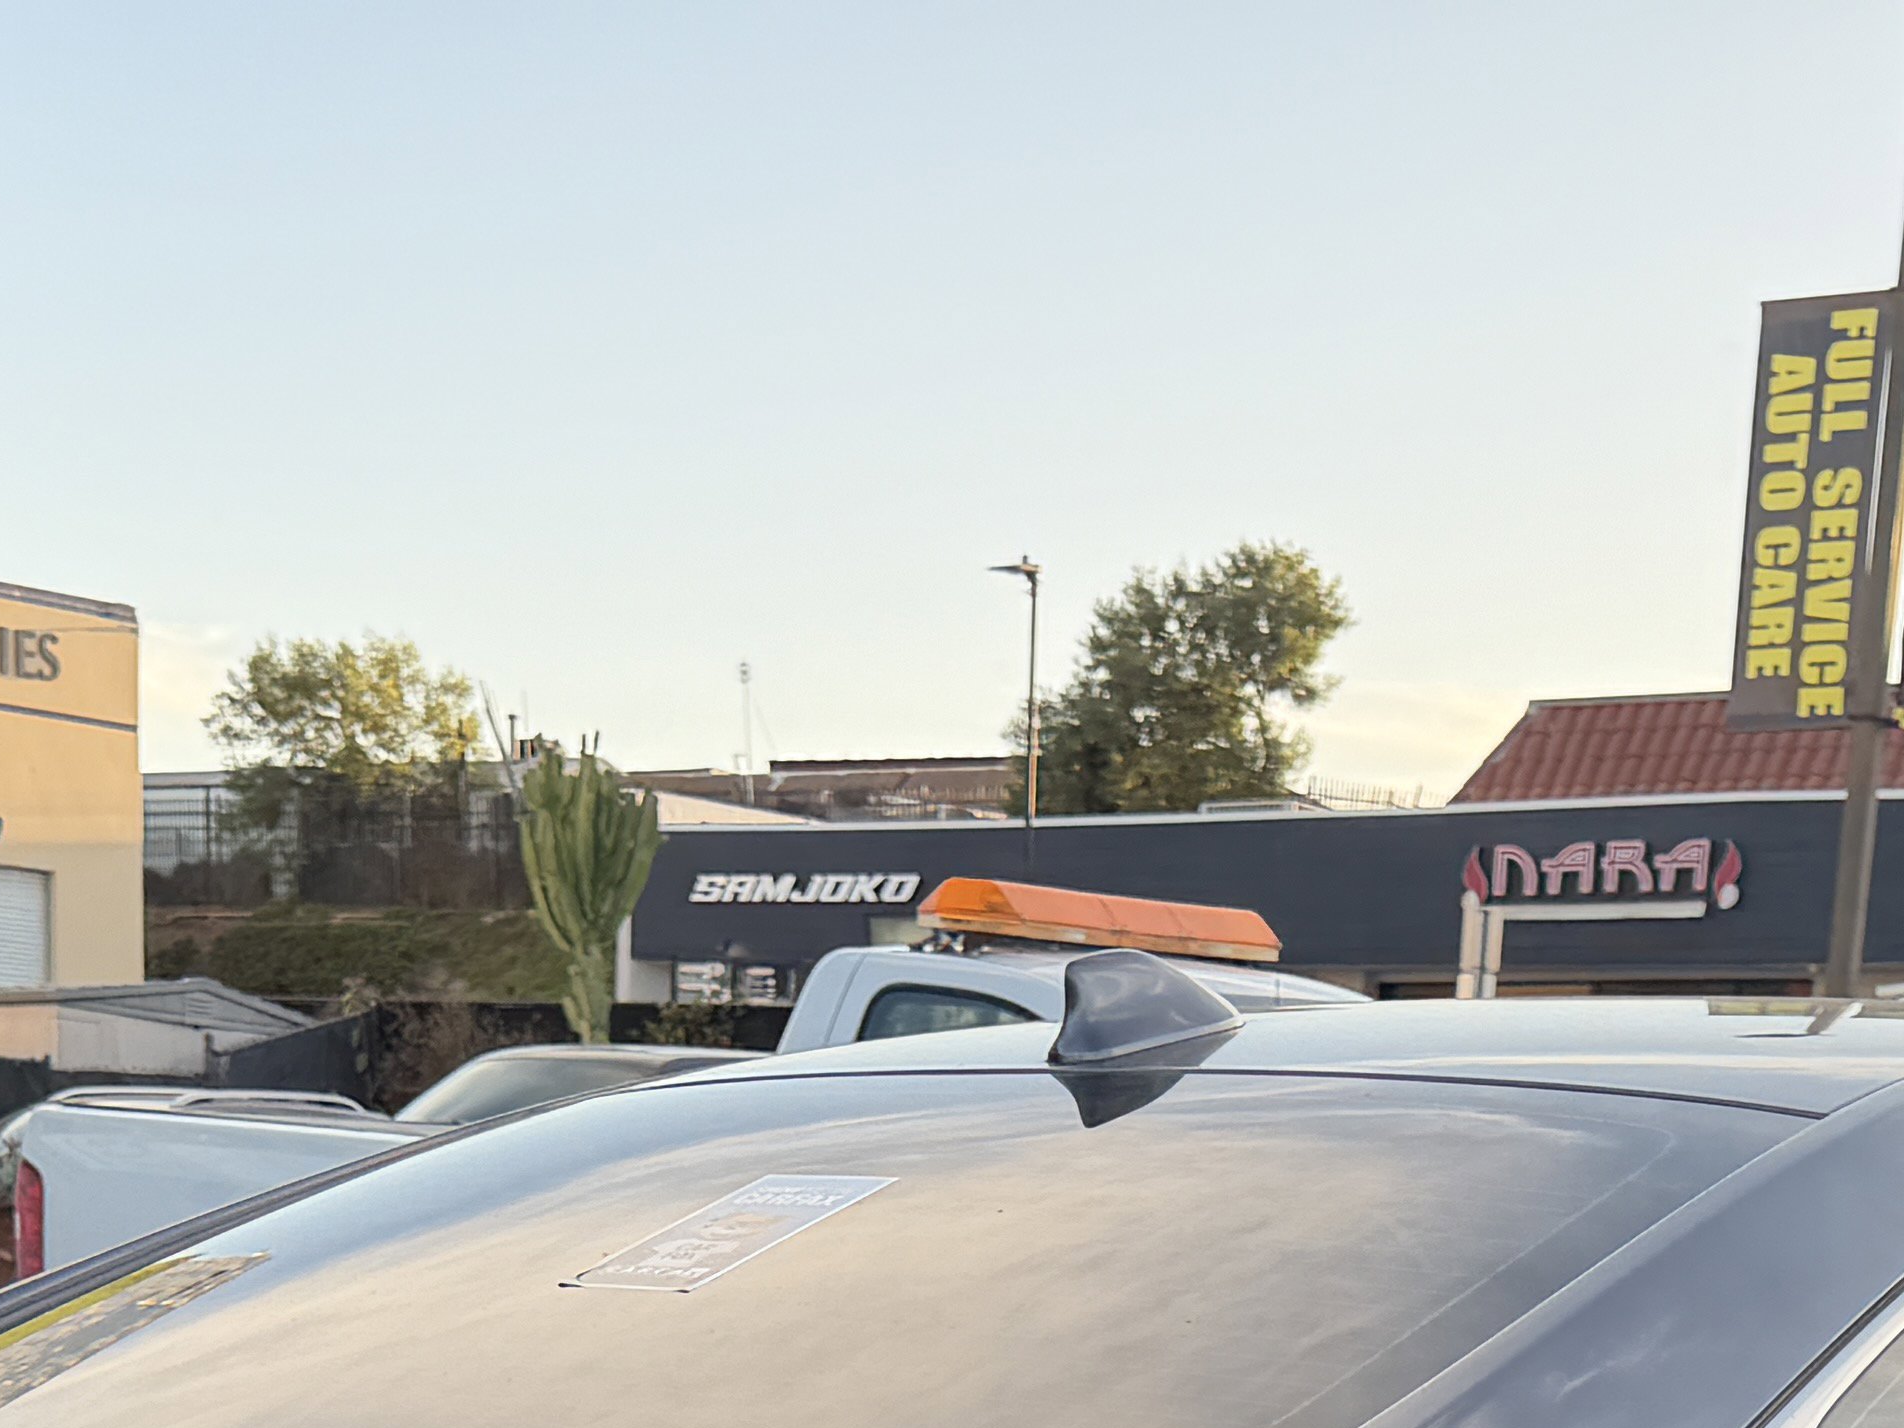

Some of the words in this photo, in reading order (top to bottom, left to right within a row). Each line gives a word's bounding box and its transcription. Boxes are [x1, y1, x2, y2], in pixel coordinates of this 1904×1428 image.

[1758, 354, 1818, 512] AUTO
[1818, 306, 1880, 442] FULL
[1744, 525, 1802, 681] CARE
[1795, 466, 1864, 719] SERVICE
[688, 872, 922, 904] SAMJOKO
[1491, 837, 1711, 897] NARA
